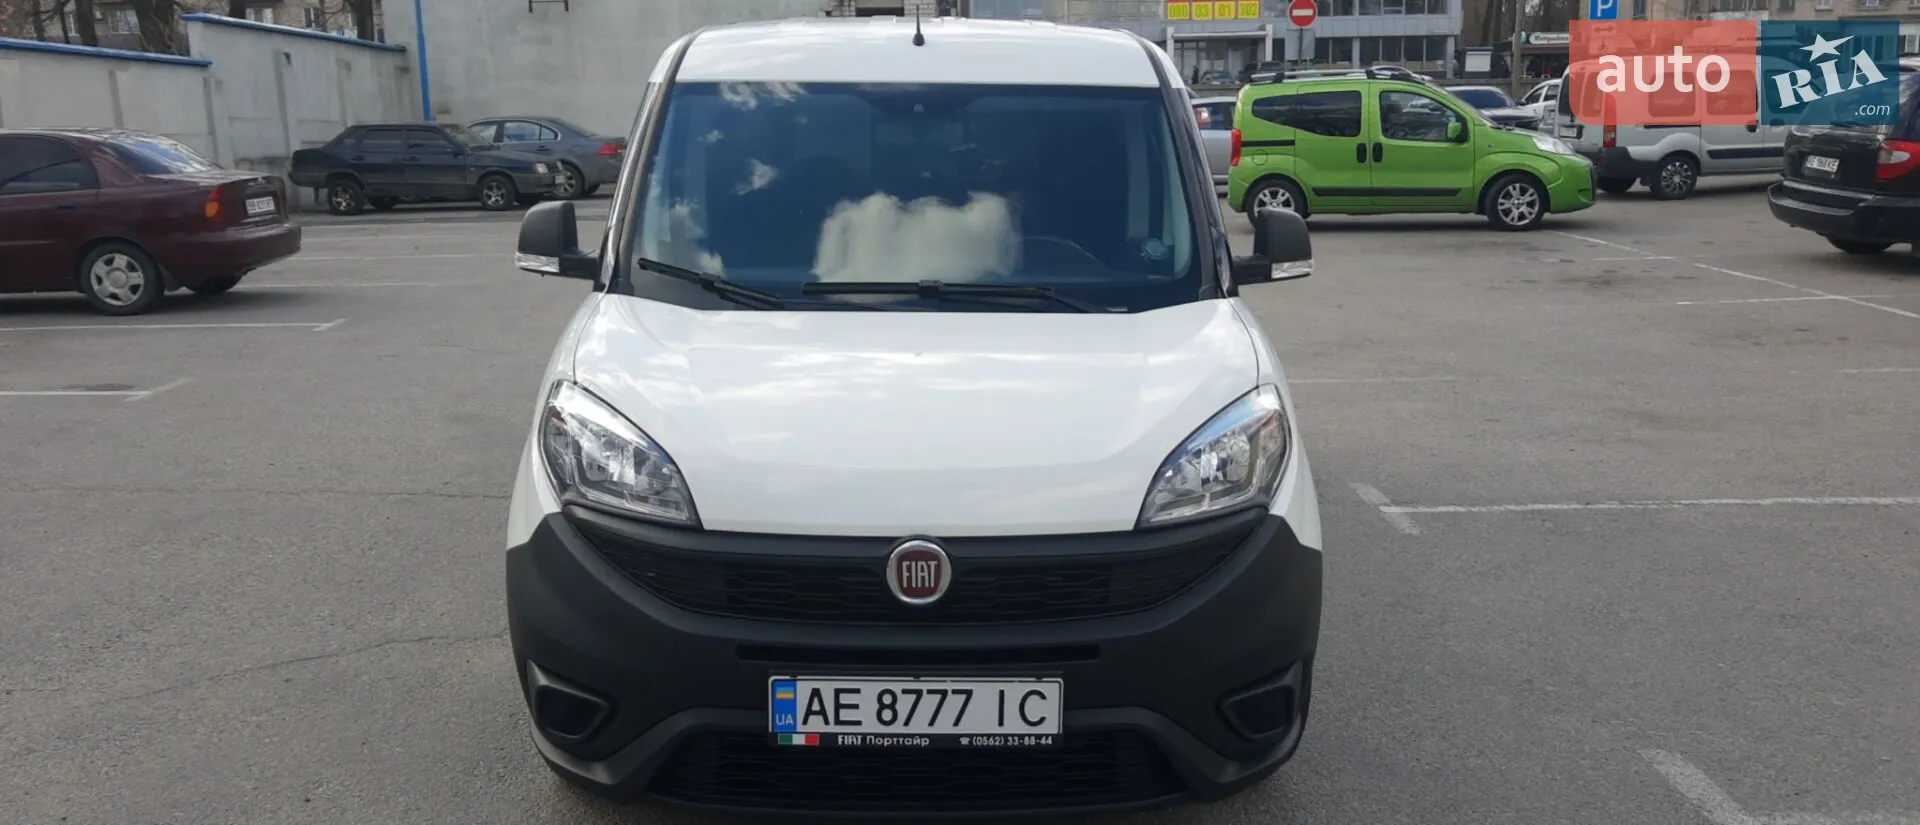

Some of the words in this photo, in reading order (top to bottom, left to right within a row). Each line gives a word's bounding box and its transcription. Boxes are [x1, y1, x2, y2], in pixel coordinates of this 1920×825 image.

[1597, 0, 1614, 17] P
[902, 560, 938, 588] FIAT
[801, 687, 863, 726] AE
[875, 688, 974, 727] 8777
[775, 714, 794, 726] UA
[837, 735, 863, 746] FIAT
[866, 734, 930, 748] Порттайр
[972, 735, 1005, 747] (0562)
[1007, 735, 1053, 746] 33-88-44
